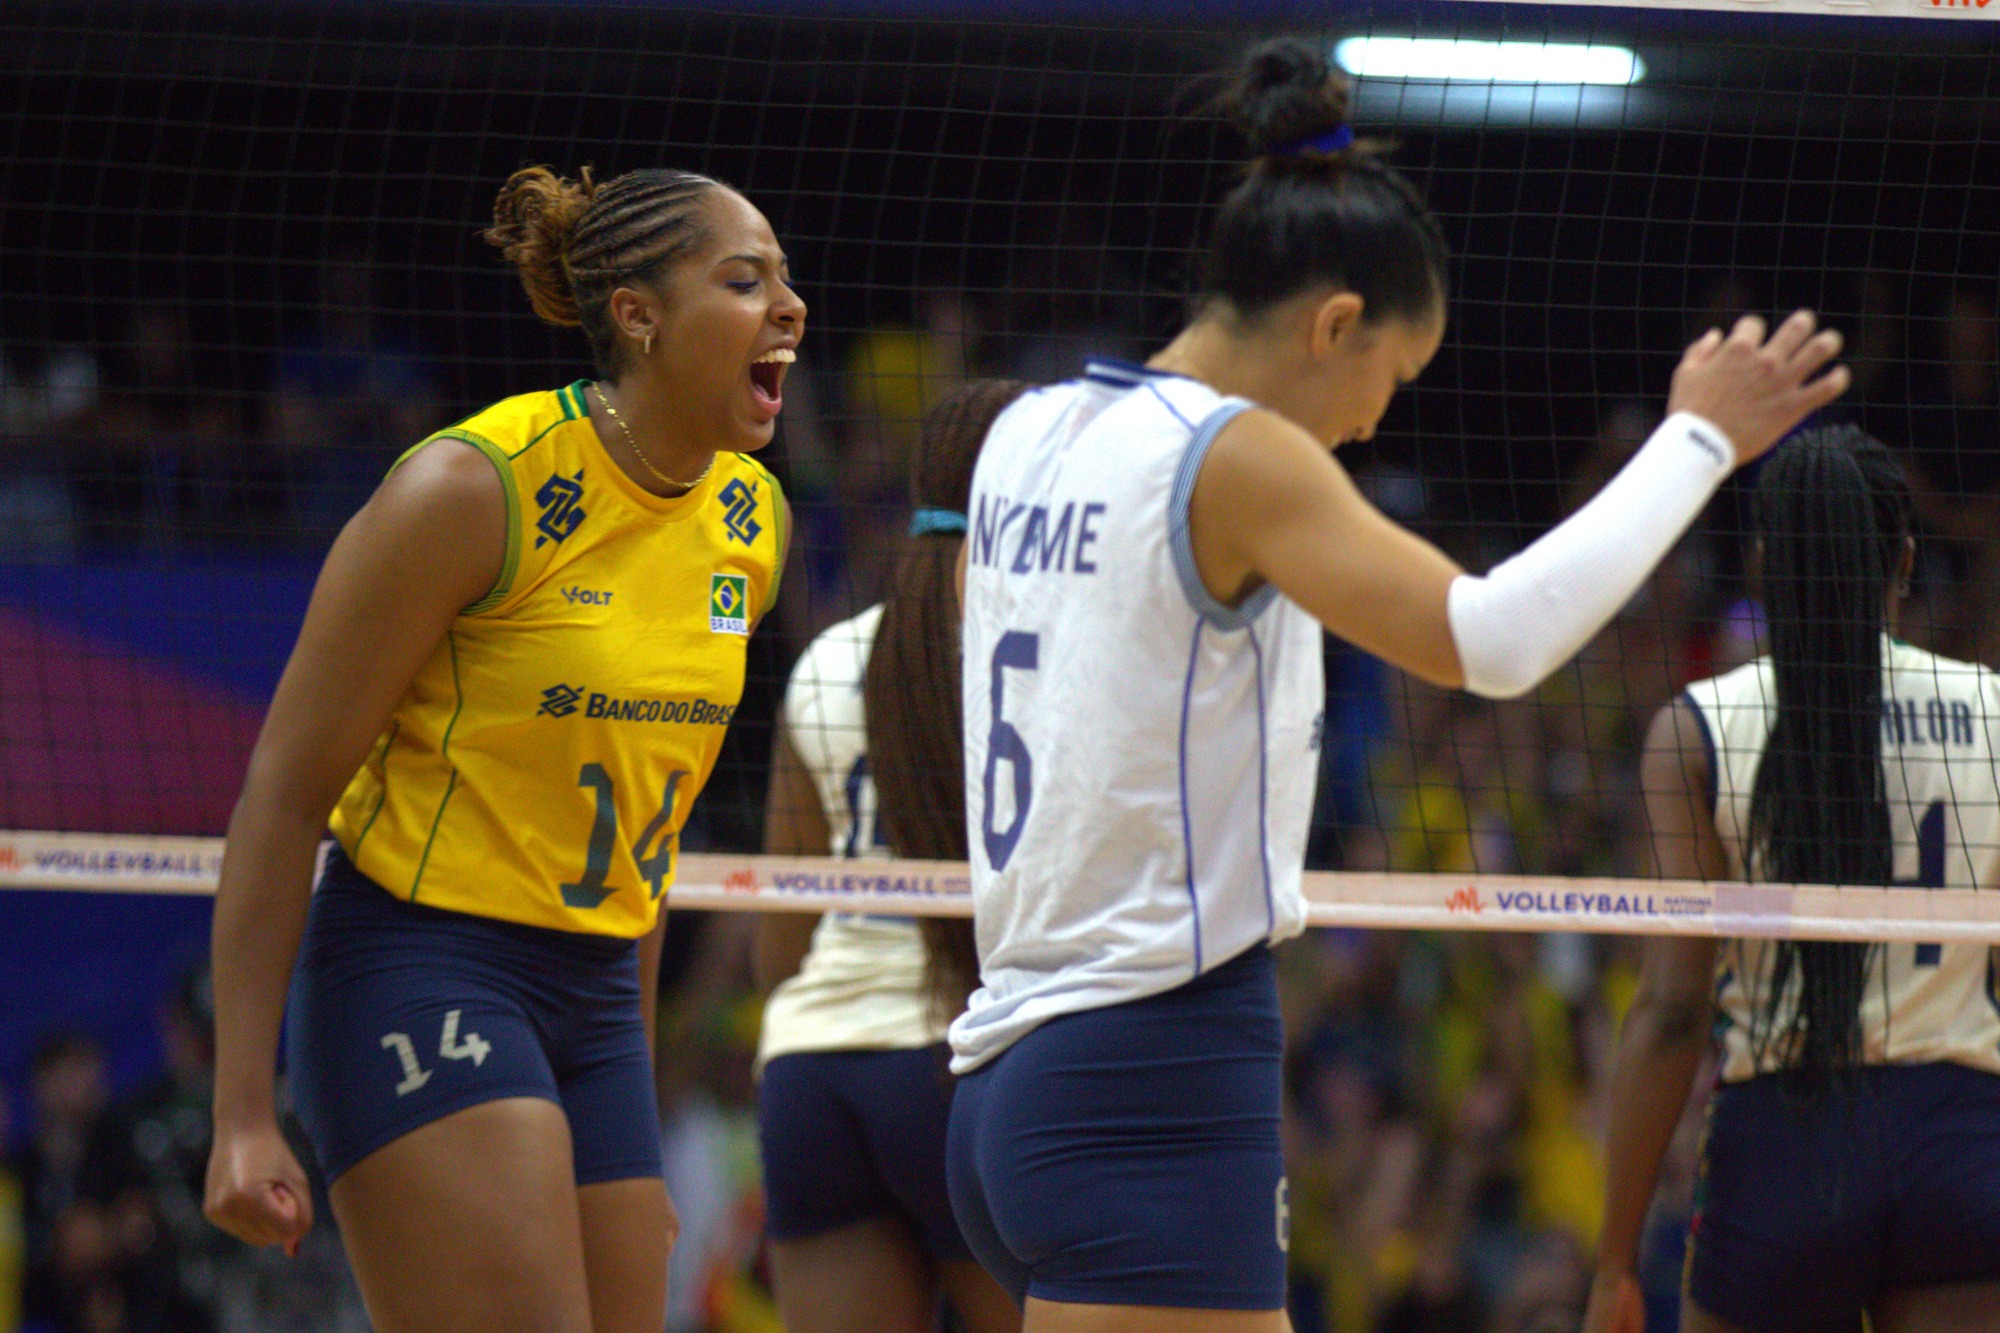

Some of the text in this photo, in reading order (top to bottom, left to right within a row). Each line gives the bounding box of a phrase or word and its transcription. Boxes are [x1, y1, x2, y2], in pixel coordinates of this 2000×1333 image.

[561, 586, 614, 606] VOLT
[711, 617, 748, 632] BRASIL
[586, 693, 660, 722] BANCO
[661, 701, 689, 723] DO
[982, 629, 1040, 874] 6
[559, 762, 691, 909] 14
[34, 850, 202, 878] VOLLEYBALL
[772, 872, 936, 898] VOLLEYBALL
[1496, 890, 1660, 916] VOLLEYBALL
[380, 1009, 492, 1098] 14
